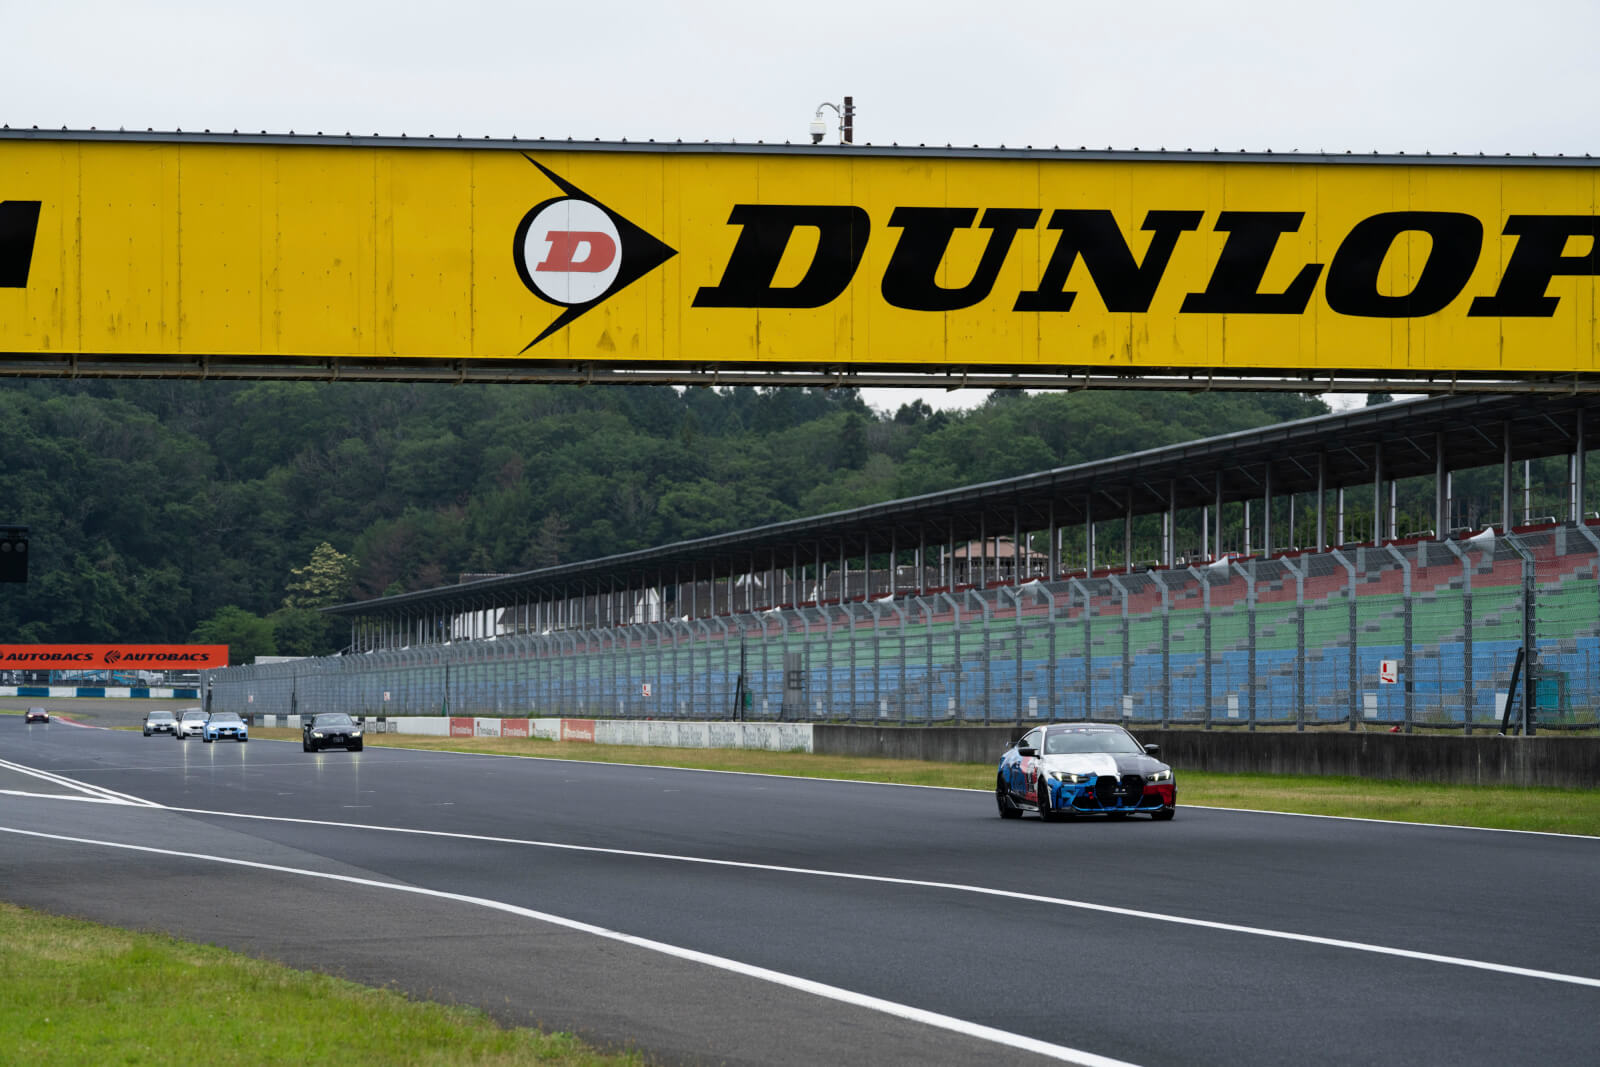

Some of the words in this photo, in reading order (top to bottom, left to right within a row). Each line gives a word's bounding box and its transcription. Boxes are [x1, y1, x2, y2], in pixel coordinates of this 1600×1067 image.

[535, 230, 617, 273] D
[691, 204, 1600, 318] DUNLOP
[5, 652, 94, 661] AUTOBACS
[122, 652, 210, 661] AUTOBACS
